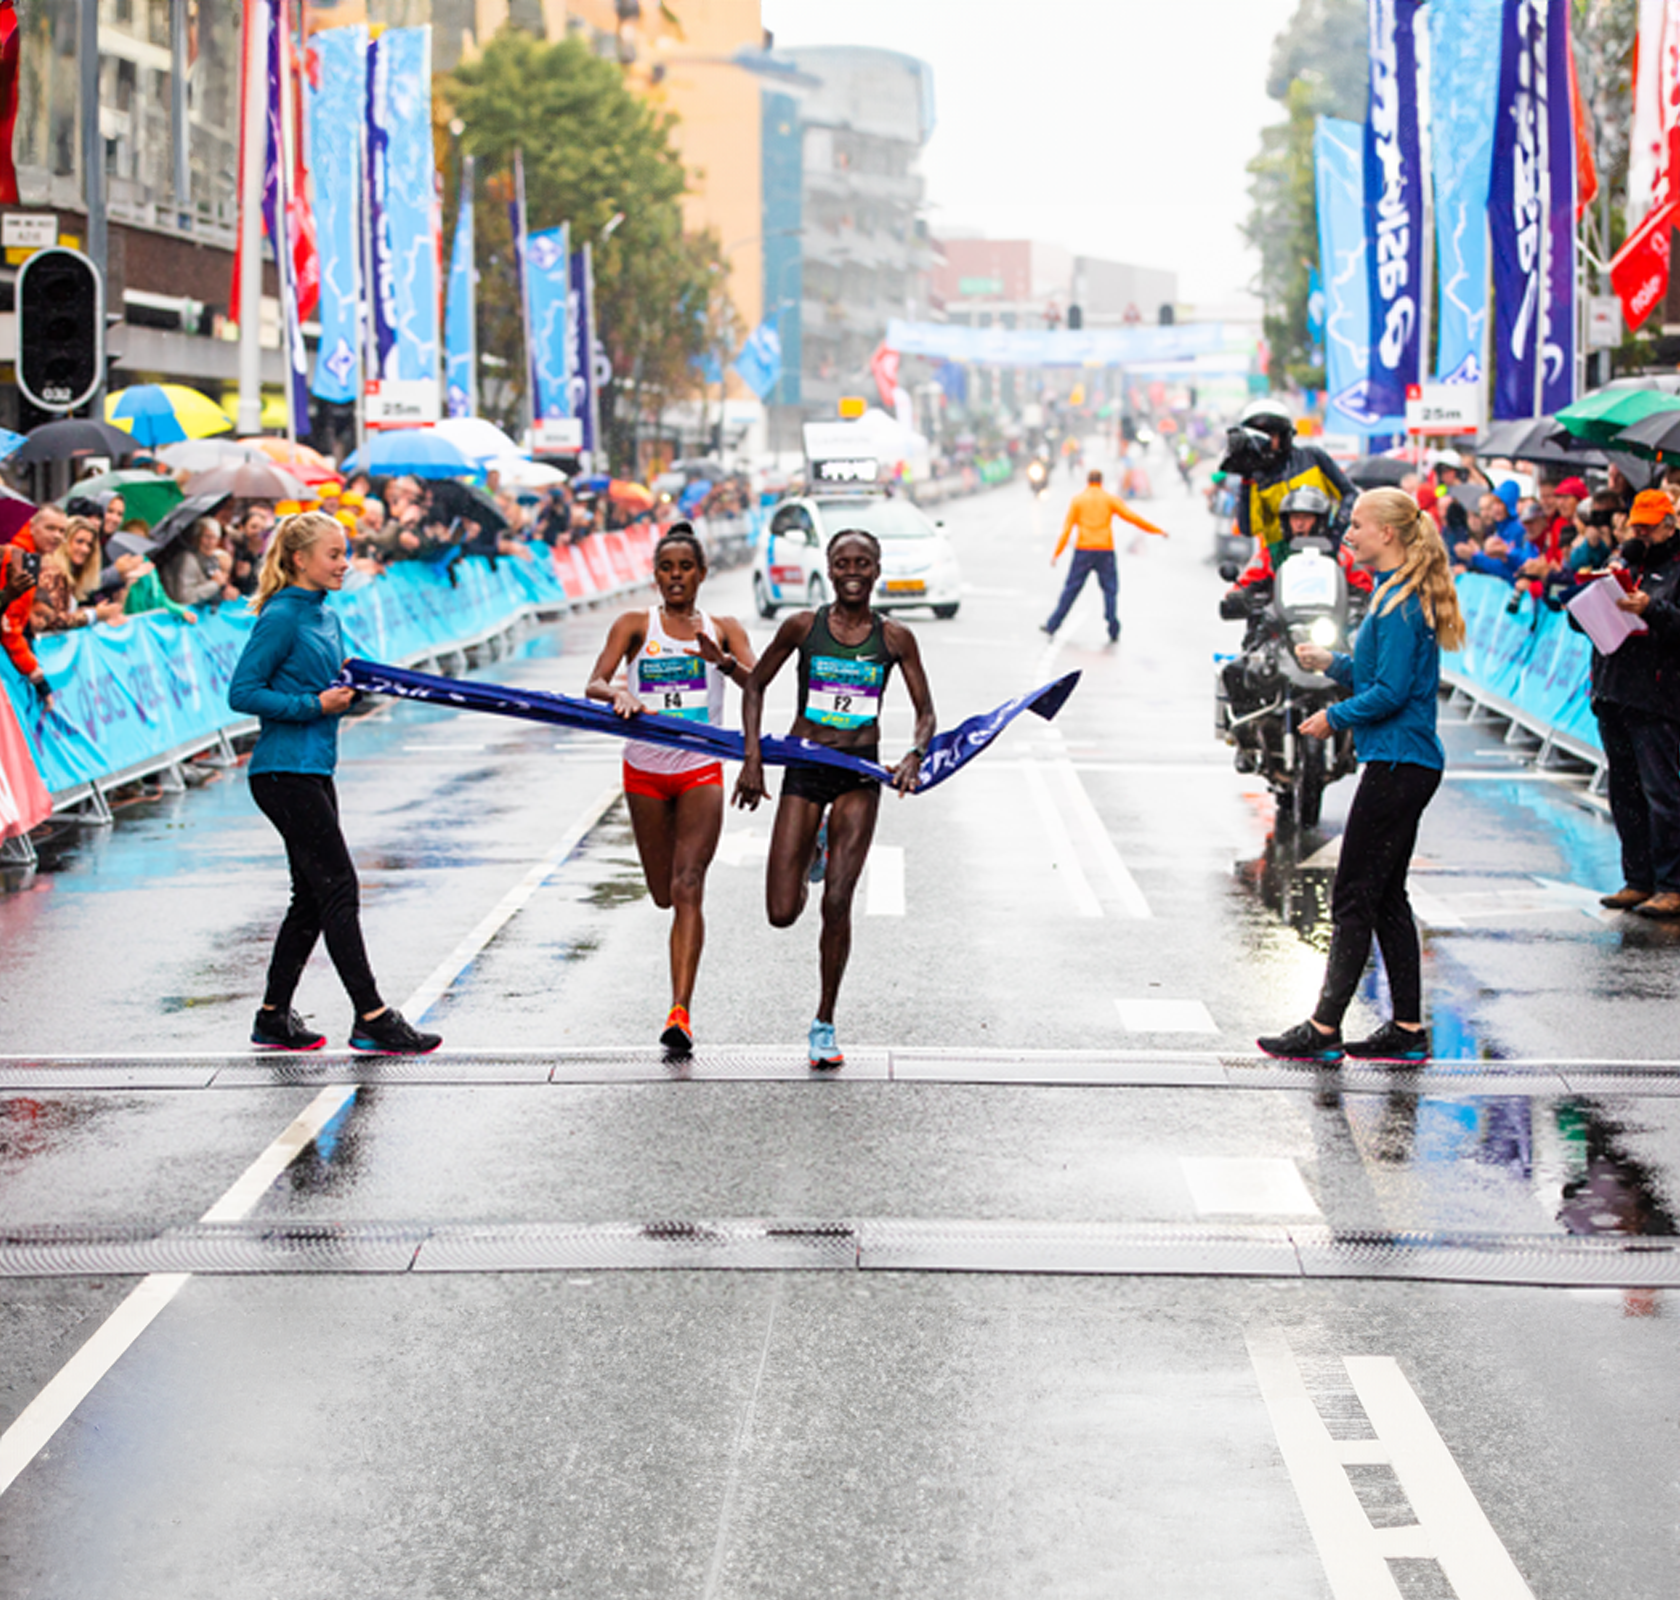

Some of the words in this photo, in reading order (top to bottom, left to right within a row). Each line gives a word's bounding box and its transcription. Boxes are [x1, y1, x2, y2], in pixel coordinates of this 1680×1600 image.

[382, 402, 421, 416] 25m
[1422, 407, 1462, 420] 25m
[665, 692, 682, 708] F4
[834, 695, 852, 712] F2
